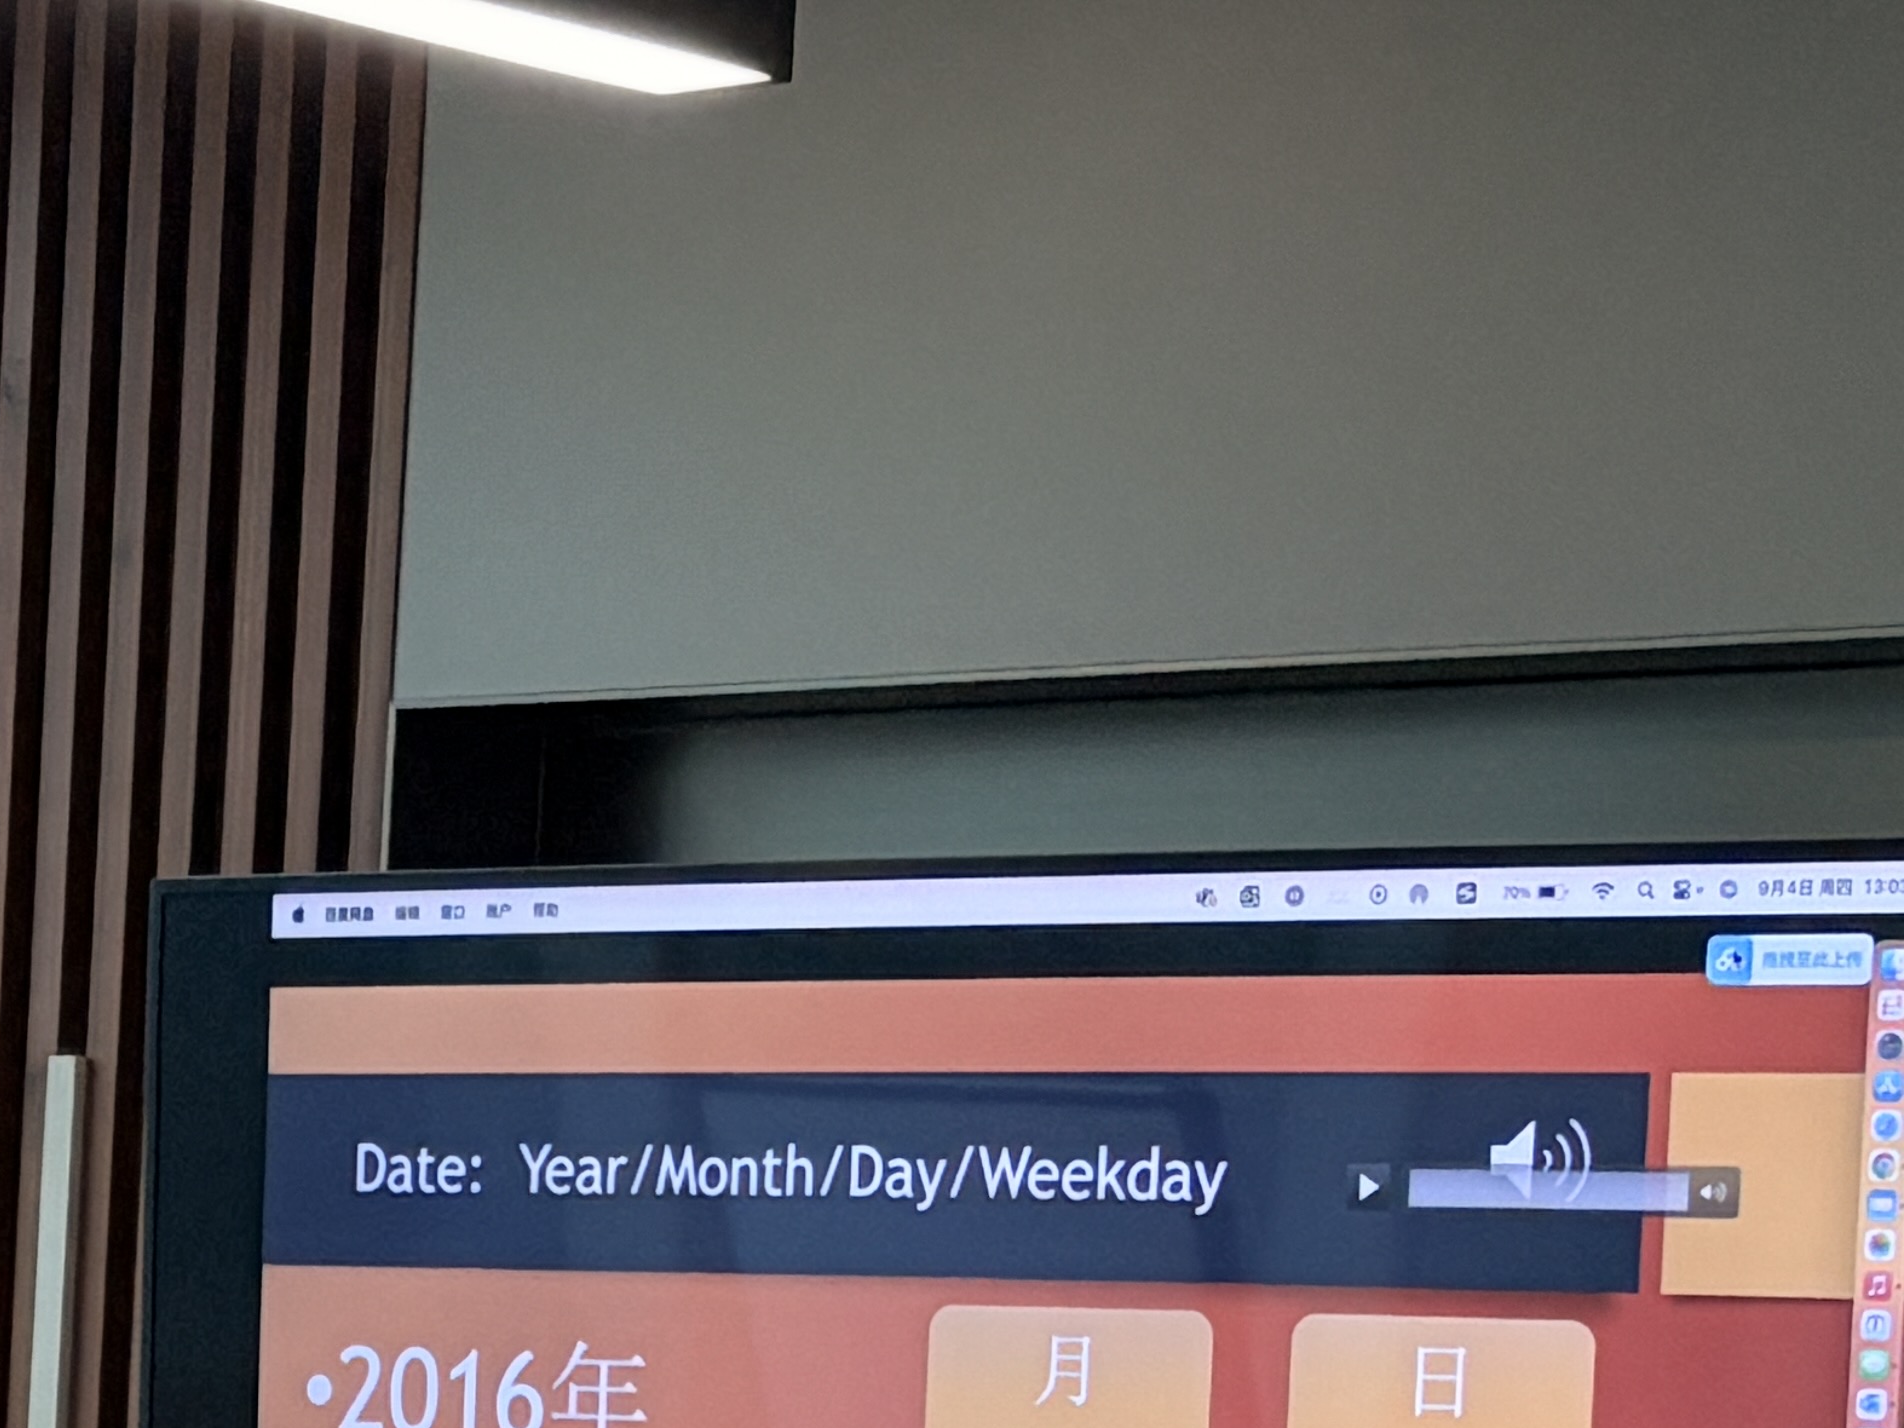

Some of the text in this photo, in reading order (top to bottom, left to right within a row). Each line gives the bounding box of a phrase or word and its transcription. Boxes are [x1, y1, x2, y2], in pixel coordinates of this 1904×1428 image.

[355, 1142, 483, 1195] Date:
[1034, 1335, 1091, 1407] 月
[1413, 1346, 1467, 1419] 日
